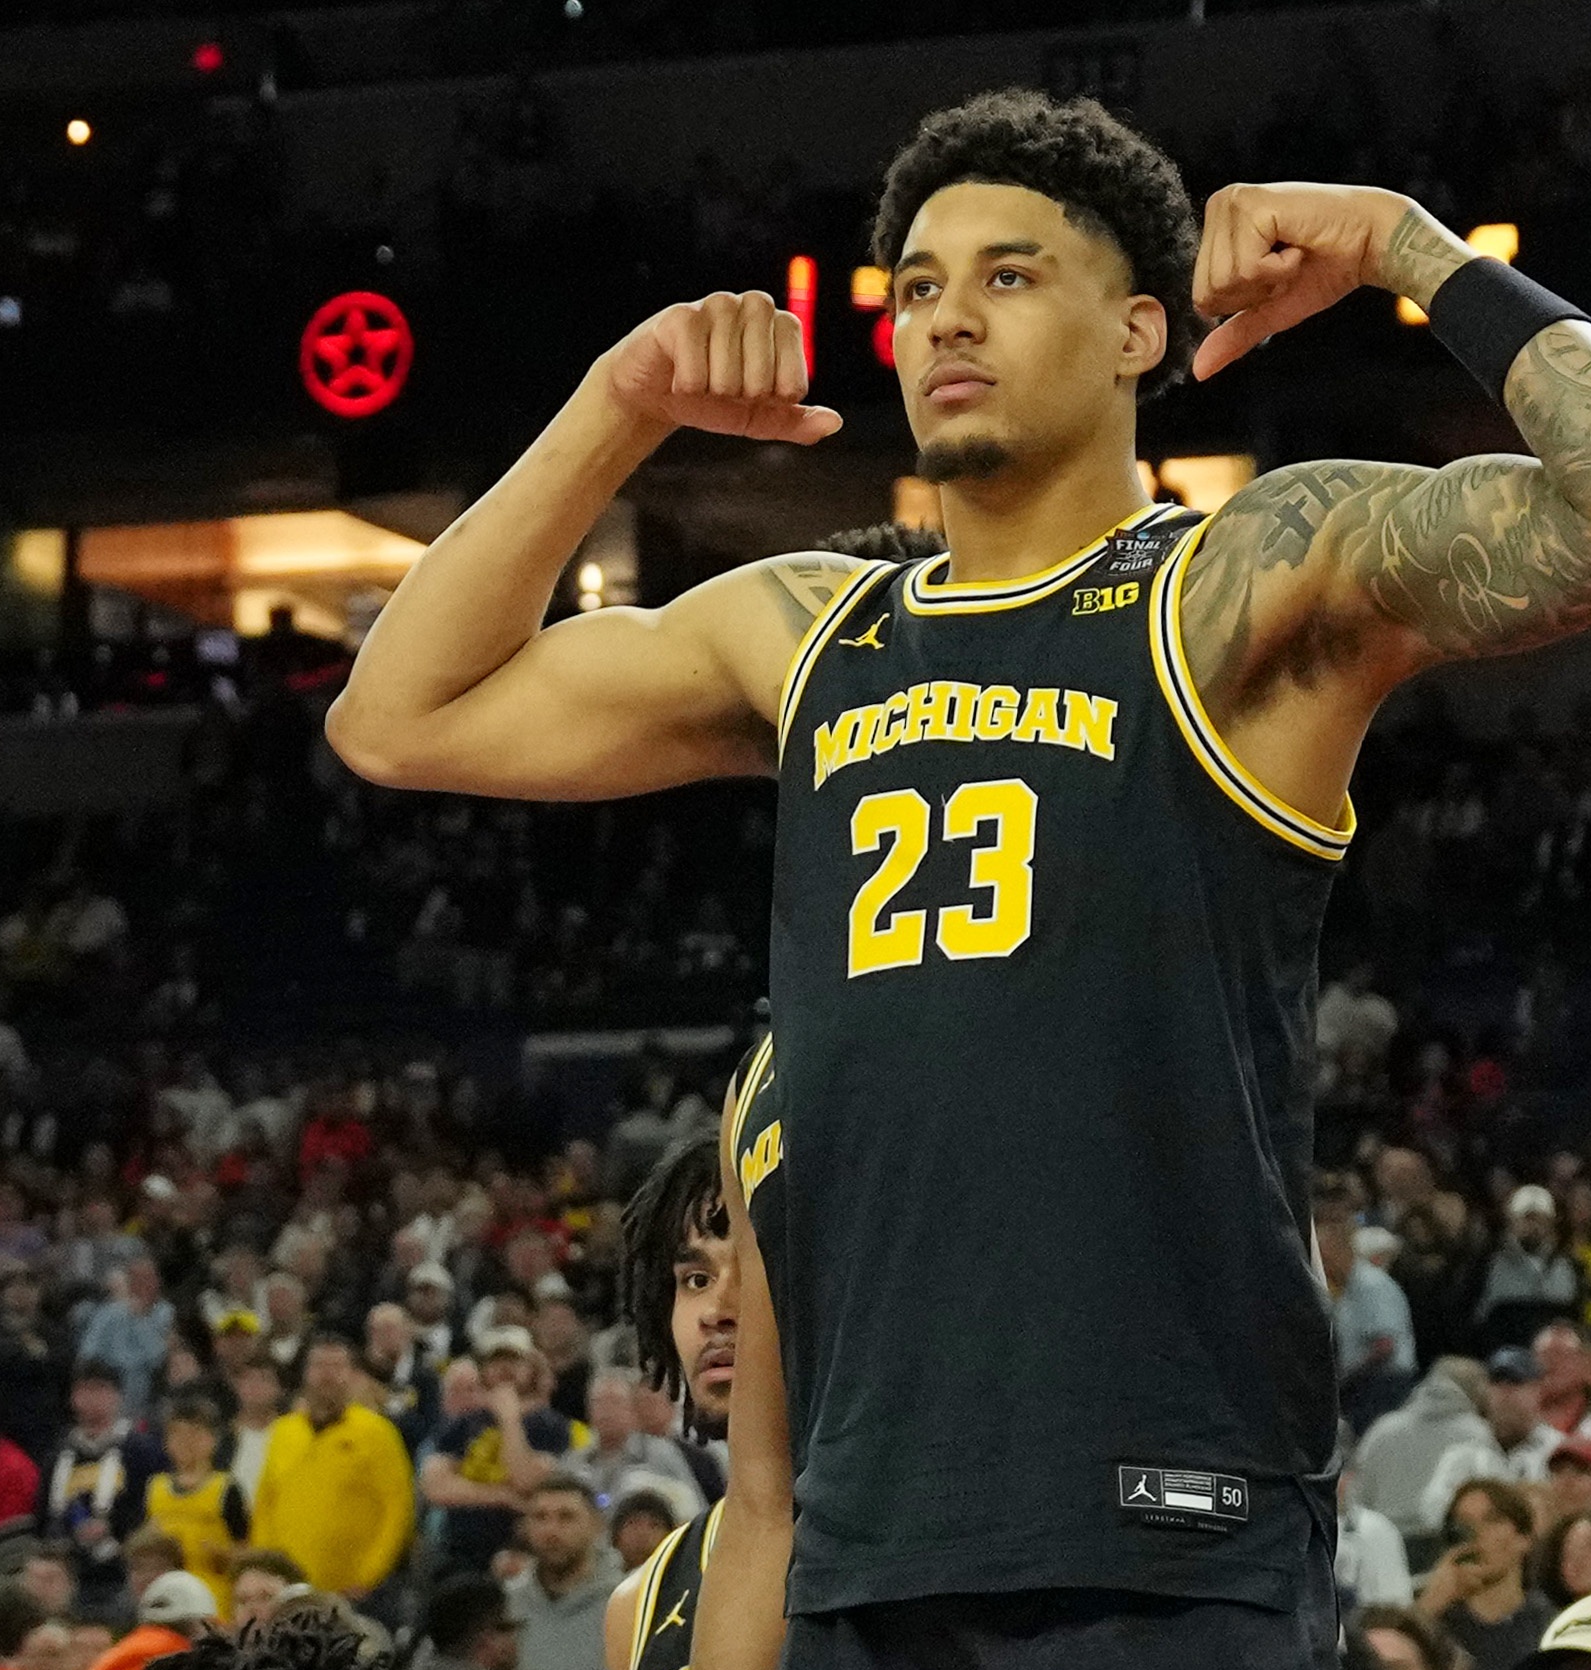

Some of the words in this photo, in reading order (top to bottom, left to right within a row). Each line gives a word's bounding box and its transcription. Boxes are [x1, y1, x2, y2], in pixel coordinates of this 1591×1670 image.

[1116, 539, 1161, 551] FINAL
[1109, 558, 1153, 572] FOUR
[814, 680, 1118, 791] MICHIGAN
[848, 778, 1039, 979] 23
[1221, 1486, 1243, 1508] 50
